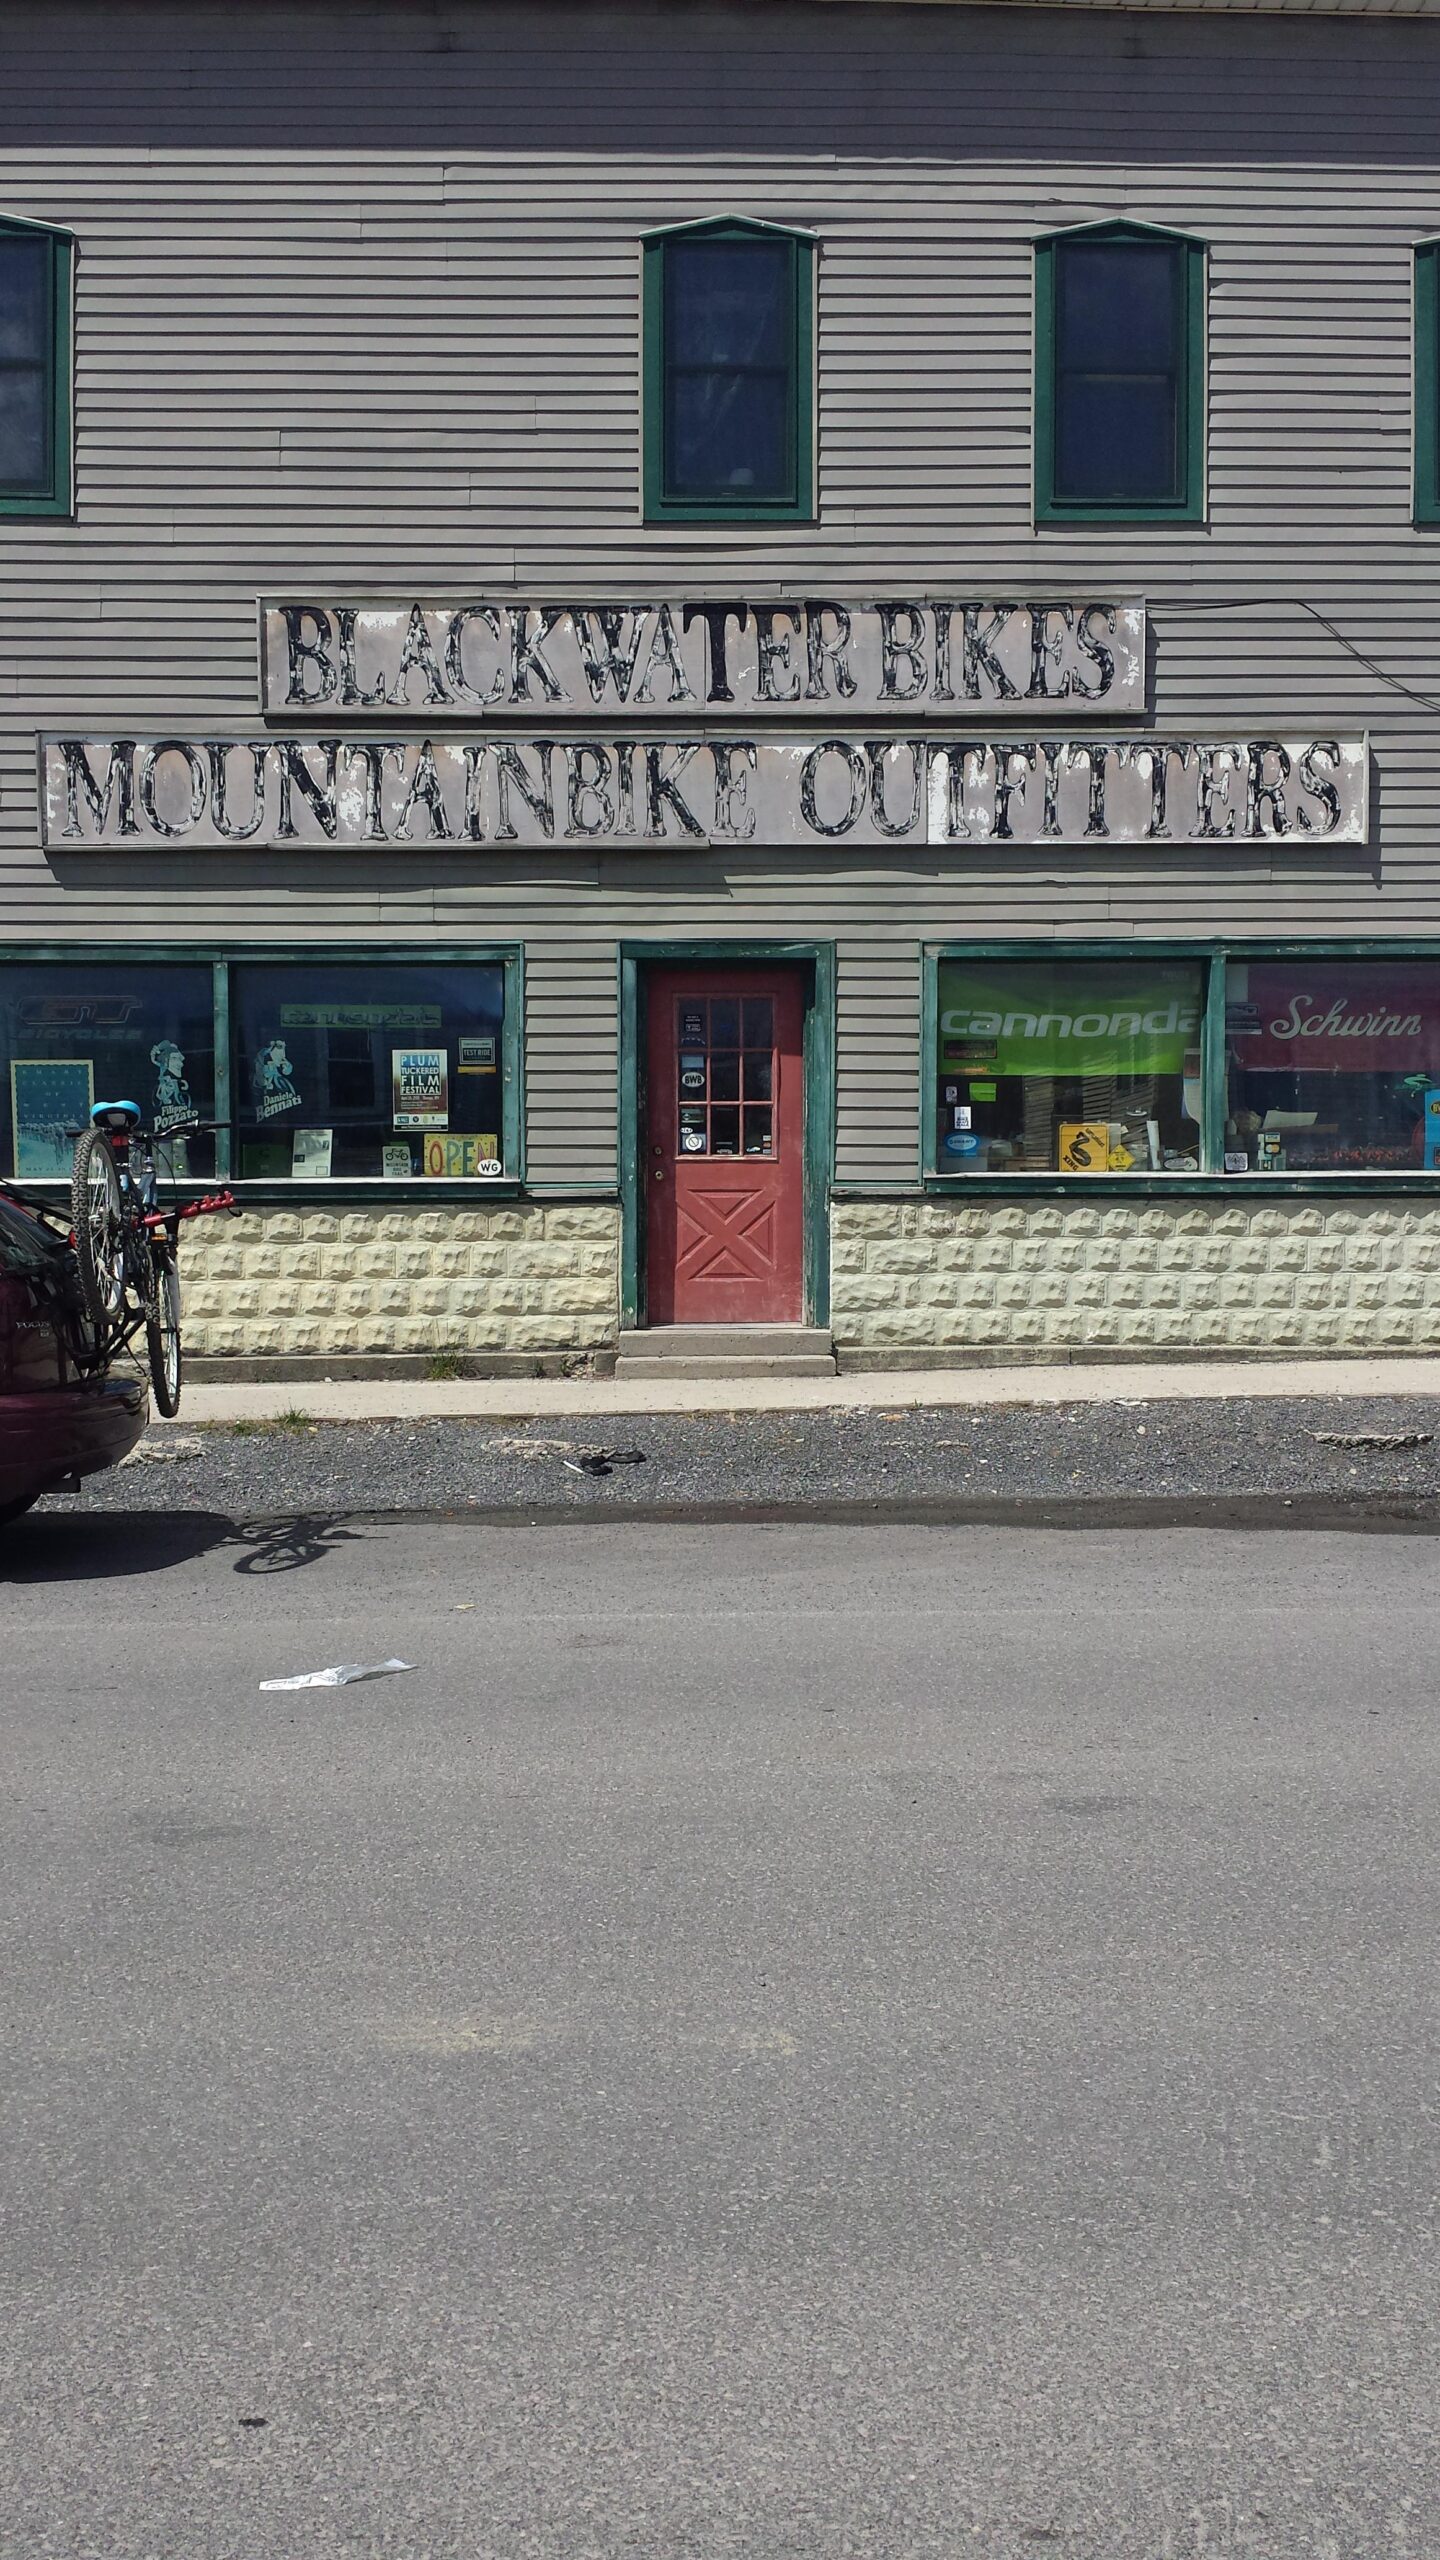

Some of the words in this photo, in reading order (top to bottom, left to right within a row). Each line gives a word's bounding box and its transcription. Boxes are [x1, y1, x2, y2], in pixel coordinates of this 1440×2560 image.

[280, 602, 857, 705] BLACKWATER
[875, 601, 1117, 702] BIKES
[799, 739, 1341, 838] OUTFITTERS
[1270, 995, 1421, 1039] Schwinn
[401, 1056, 439, 1066] PLUM
[401, 1067, 439, 1075] TUCKERED
[401, 1075, 439, 1085] FILM
[685, 1075, 702, 1084] BWB
[401, 1086, 440, 1094] FESTIVAL
[263, 1092, 294, 1106] Daniele
[161, 1104, 188, 1116] Filippo
[256, 1094, 302, 1123] Bennati
[154, 1108, 199, 1133] Pozzato
[429, 1140, 495, 1177] OPEN
[1063, 1155, 1079, 1171] XING
[480, 1163, 498, 1172] WG
[16, 1320, 50, 1329] FOCUS
